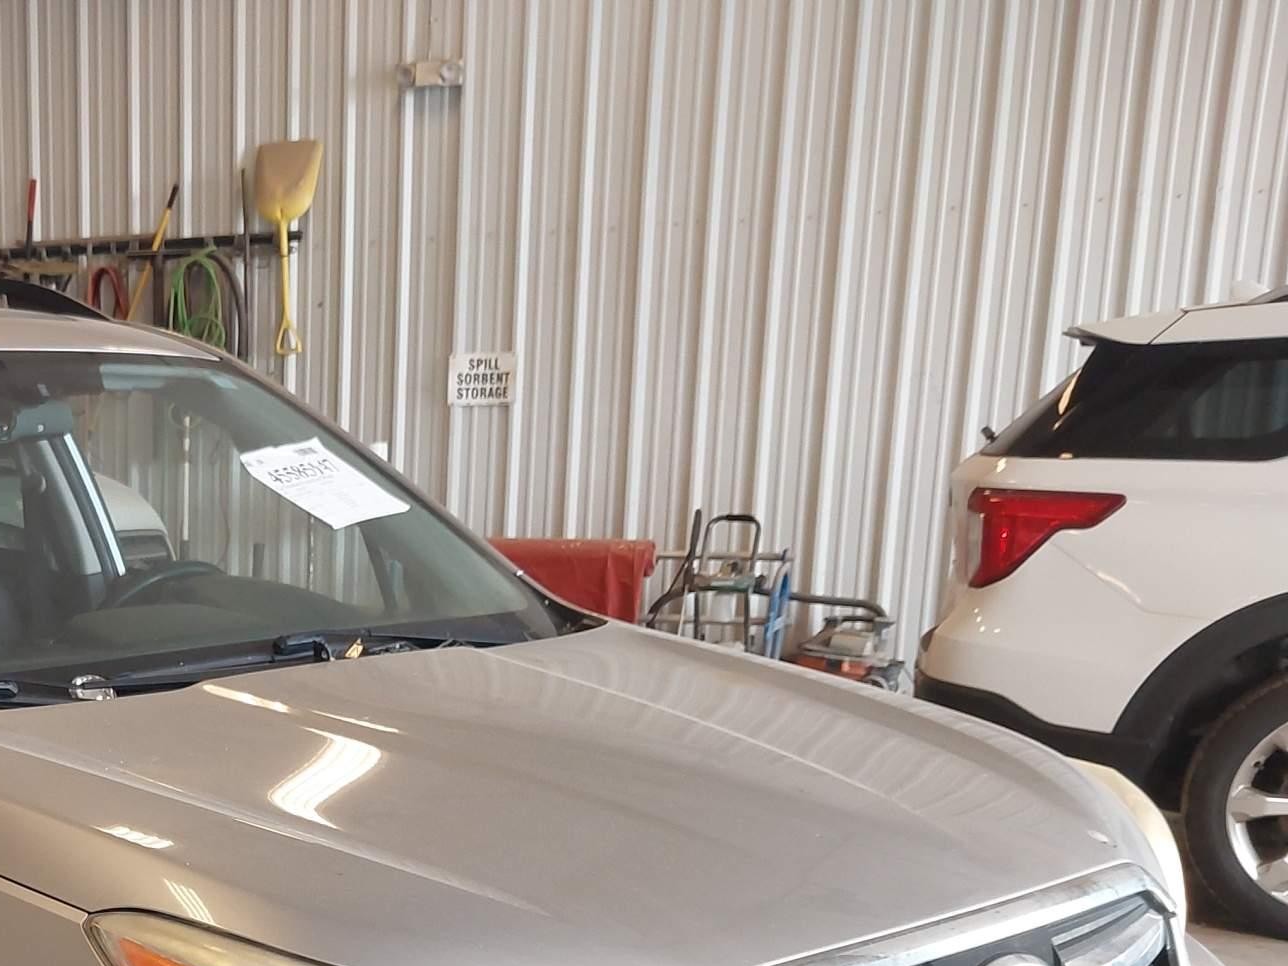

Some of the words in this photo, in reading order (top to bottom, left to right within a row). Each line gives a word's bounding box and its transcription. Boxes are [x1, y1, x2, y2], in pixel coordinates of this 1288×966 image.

[468, 358, 500, 371] SPILL
[456, 372, 510, 386] SORBENT
[456, 386, 509, 400] STORAGE
